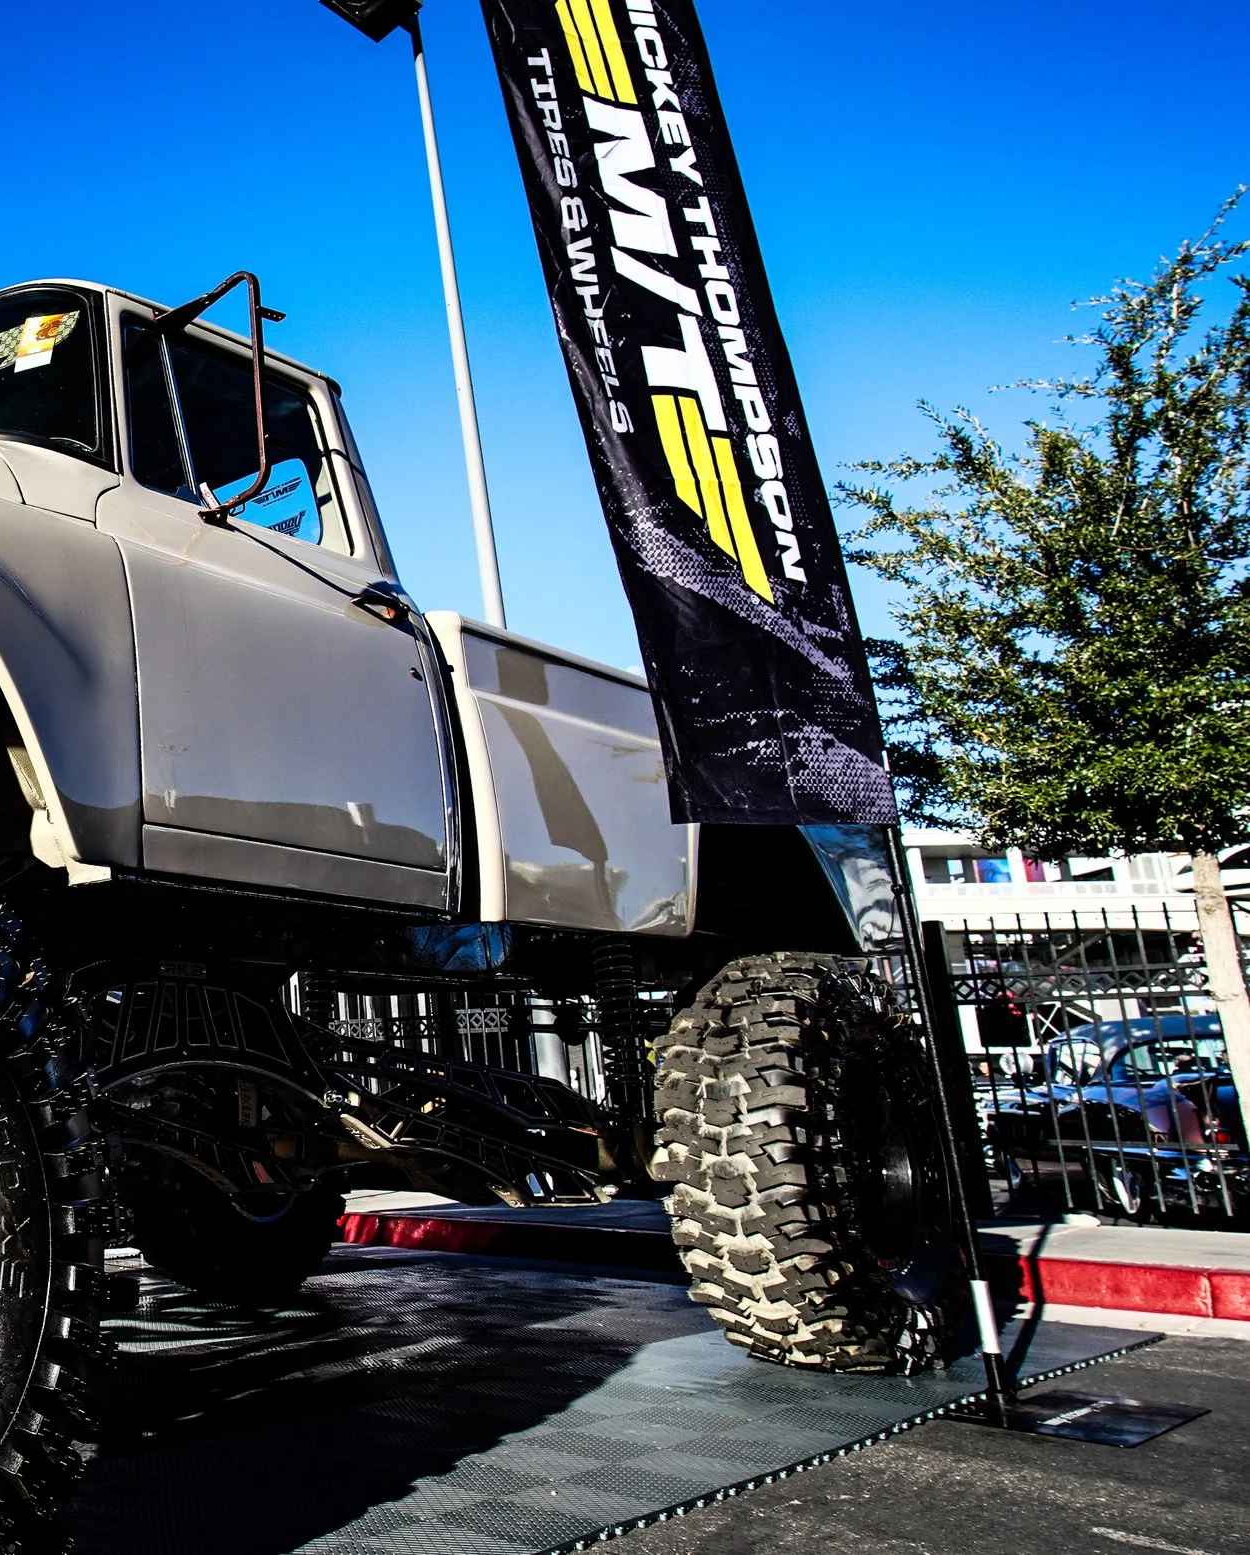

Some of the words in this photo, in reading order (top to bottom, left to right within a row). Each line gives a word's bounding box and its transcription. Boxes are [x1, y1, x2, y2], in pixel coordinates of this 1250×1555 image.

[527, 48, 578, 188] TIRES
[560, 196, 589, 231] &
[565, 236, 635, 435] WHEELS
[582, 96, 728, 433] M/T
[626, 0, 704, 187] ICKEY
[682, 196, 807, 584] THOMPSON
